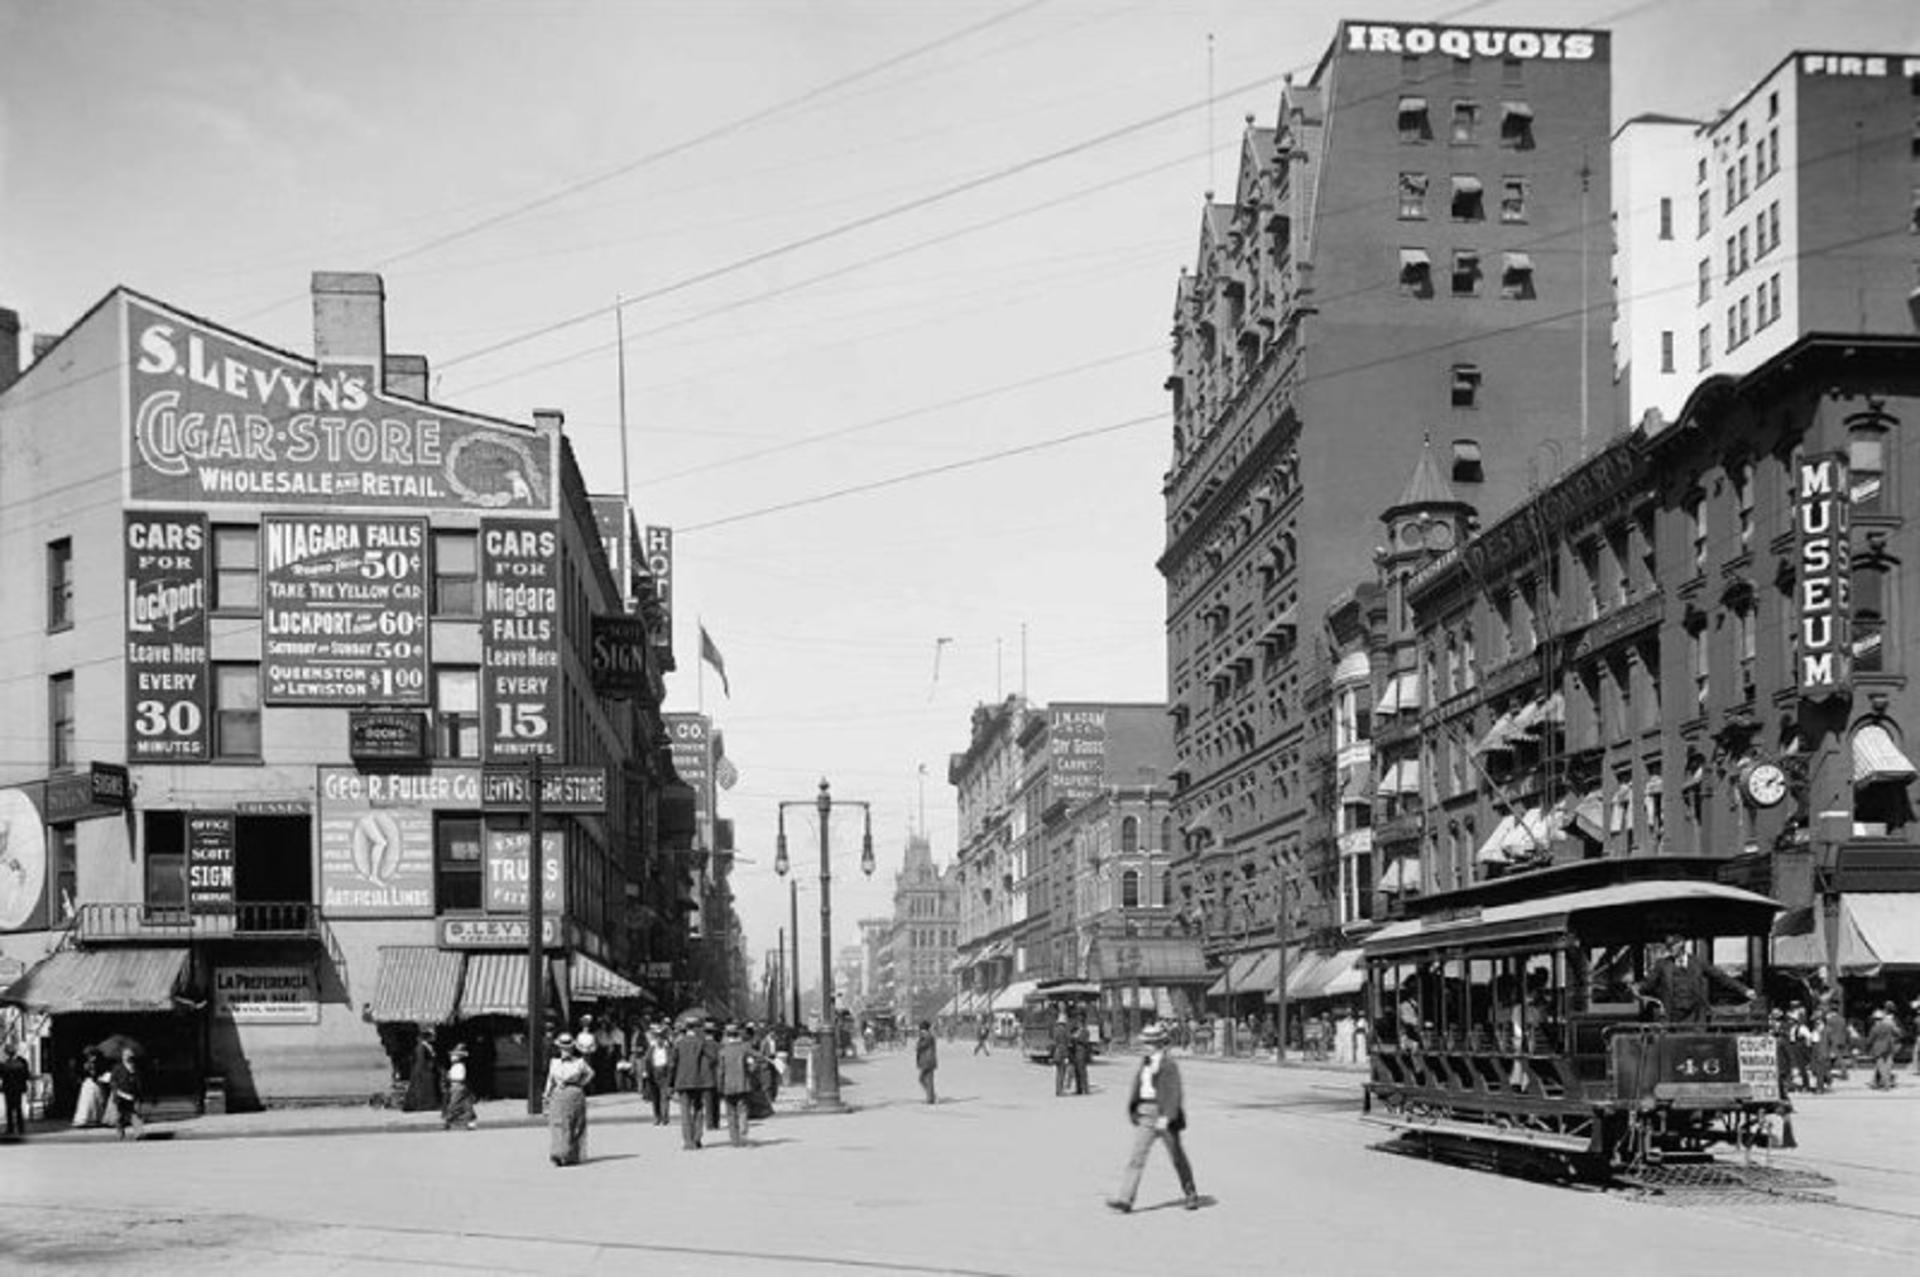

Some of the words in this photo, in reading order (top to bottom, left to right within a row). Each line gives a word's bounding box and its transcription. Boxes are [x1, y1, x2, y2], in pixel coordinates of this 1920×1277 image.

[1346, 25, 1595, 60] IROQUOIS
[1804, 56, 1887, 77] FIRE
[200, 468, 332, 495] WHOLESALE
[128, 522, 203, 551] CARS
[486, 530, 556, 557] CARS
[268, 523, 361, 573] NIAGARA
[366, 524, 422, 548] FALLS
[138, 556, 193, 570] FOR
[495, 563, 547, 576] FOR
[1800, 460, 1834, 687] MUSEUM
[268, 582, 306, 599] TAKE
[335, 582, 390, 599] YELLOW
[486, 580, 556, 618] Niagara
[268, 608, 353, 635] LOCKPORT
[492, 618, 551, 640] FALLS
[138, 673, 197, 690] EVERY
[287, 682, 367, 695] LEWISTON
[496, 676, 549, 695] EVERY
[135, 700, 201, 736] 30
[495, 702, 548, 738] 15
[136, 741, 201, 753] MINUTES
[493, 743, 555, 755] MINUTES
[369, 774, 386, 800] R.
[389, 774, 448, 800] FULLER
[191, 848, 231, 860] SCOTT
[190, 866, 234, 887] SIGN
[489, 858, 558, 882] TRUS
[218, 974, 234, 990] LA
[1675, 1058, 1720, 1075] 46
